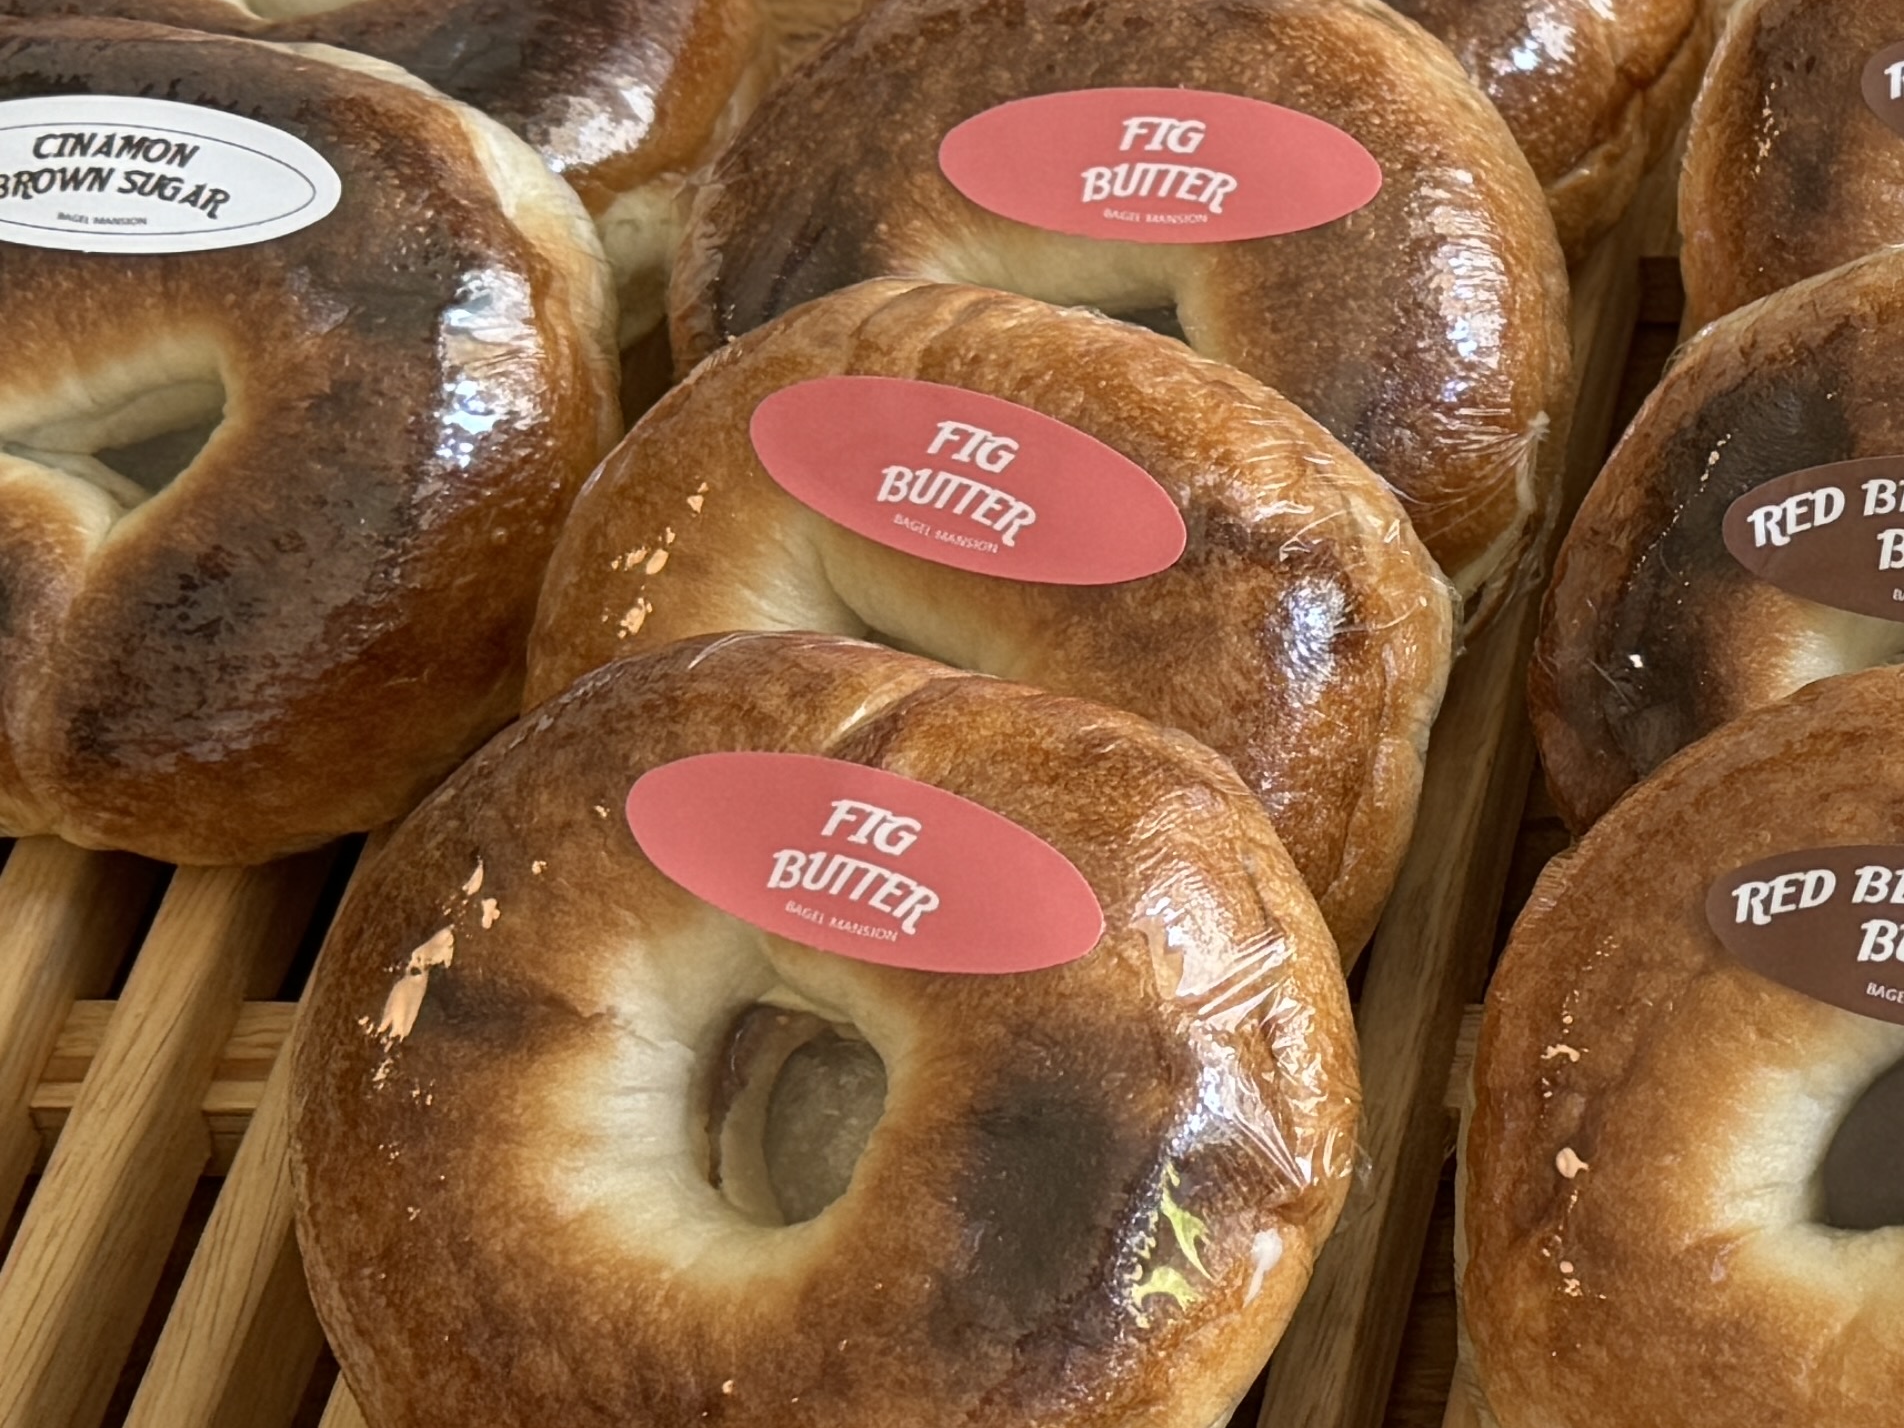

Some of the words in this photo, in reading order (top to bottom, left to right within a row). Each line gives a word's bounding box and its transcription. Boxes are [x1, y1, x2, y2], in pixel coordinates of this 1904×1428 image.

[32, 131, 201, 169] CINAMON
[1118, 115, 1206, 154] FIG
[116, 169, 232, 220] SUGAR
[1080, 161, 1238, 215] BUTTER
[925, 420, 1019, 472] FIG
[876, 465, 1037, 547] BUTTER
[1746, 486, 1846, 549] RED
[820, 798, 922, 856] FIG
[766, 848, 940, 935] BUTTER
[1730, 868, 1837, 927] RED
[784, 899, 825, 927] BAGEL
[829, 916, 899, 943] MANSION
